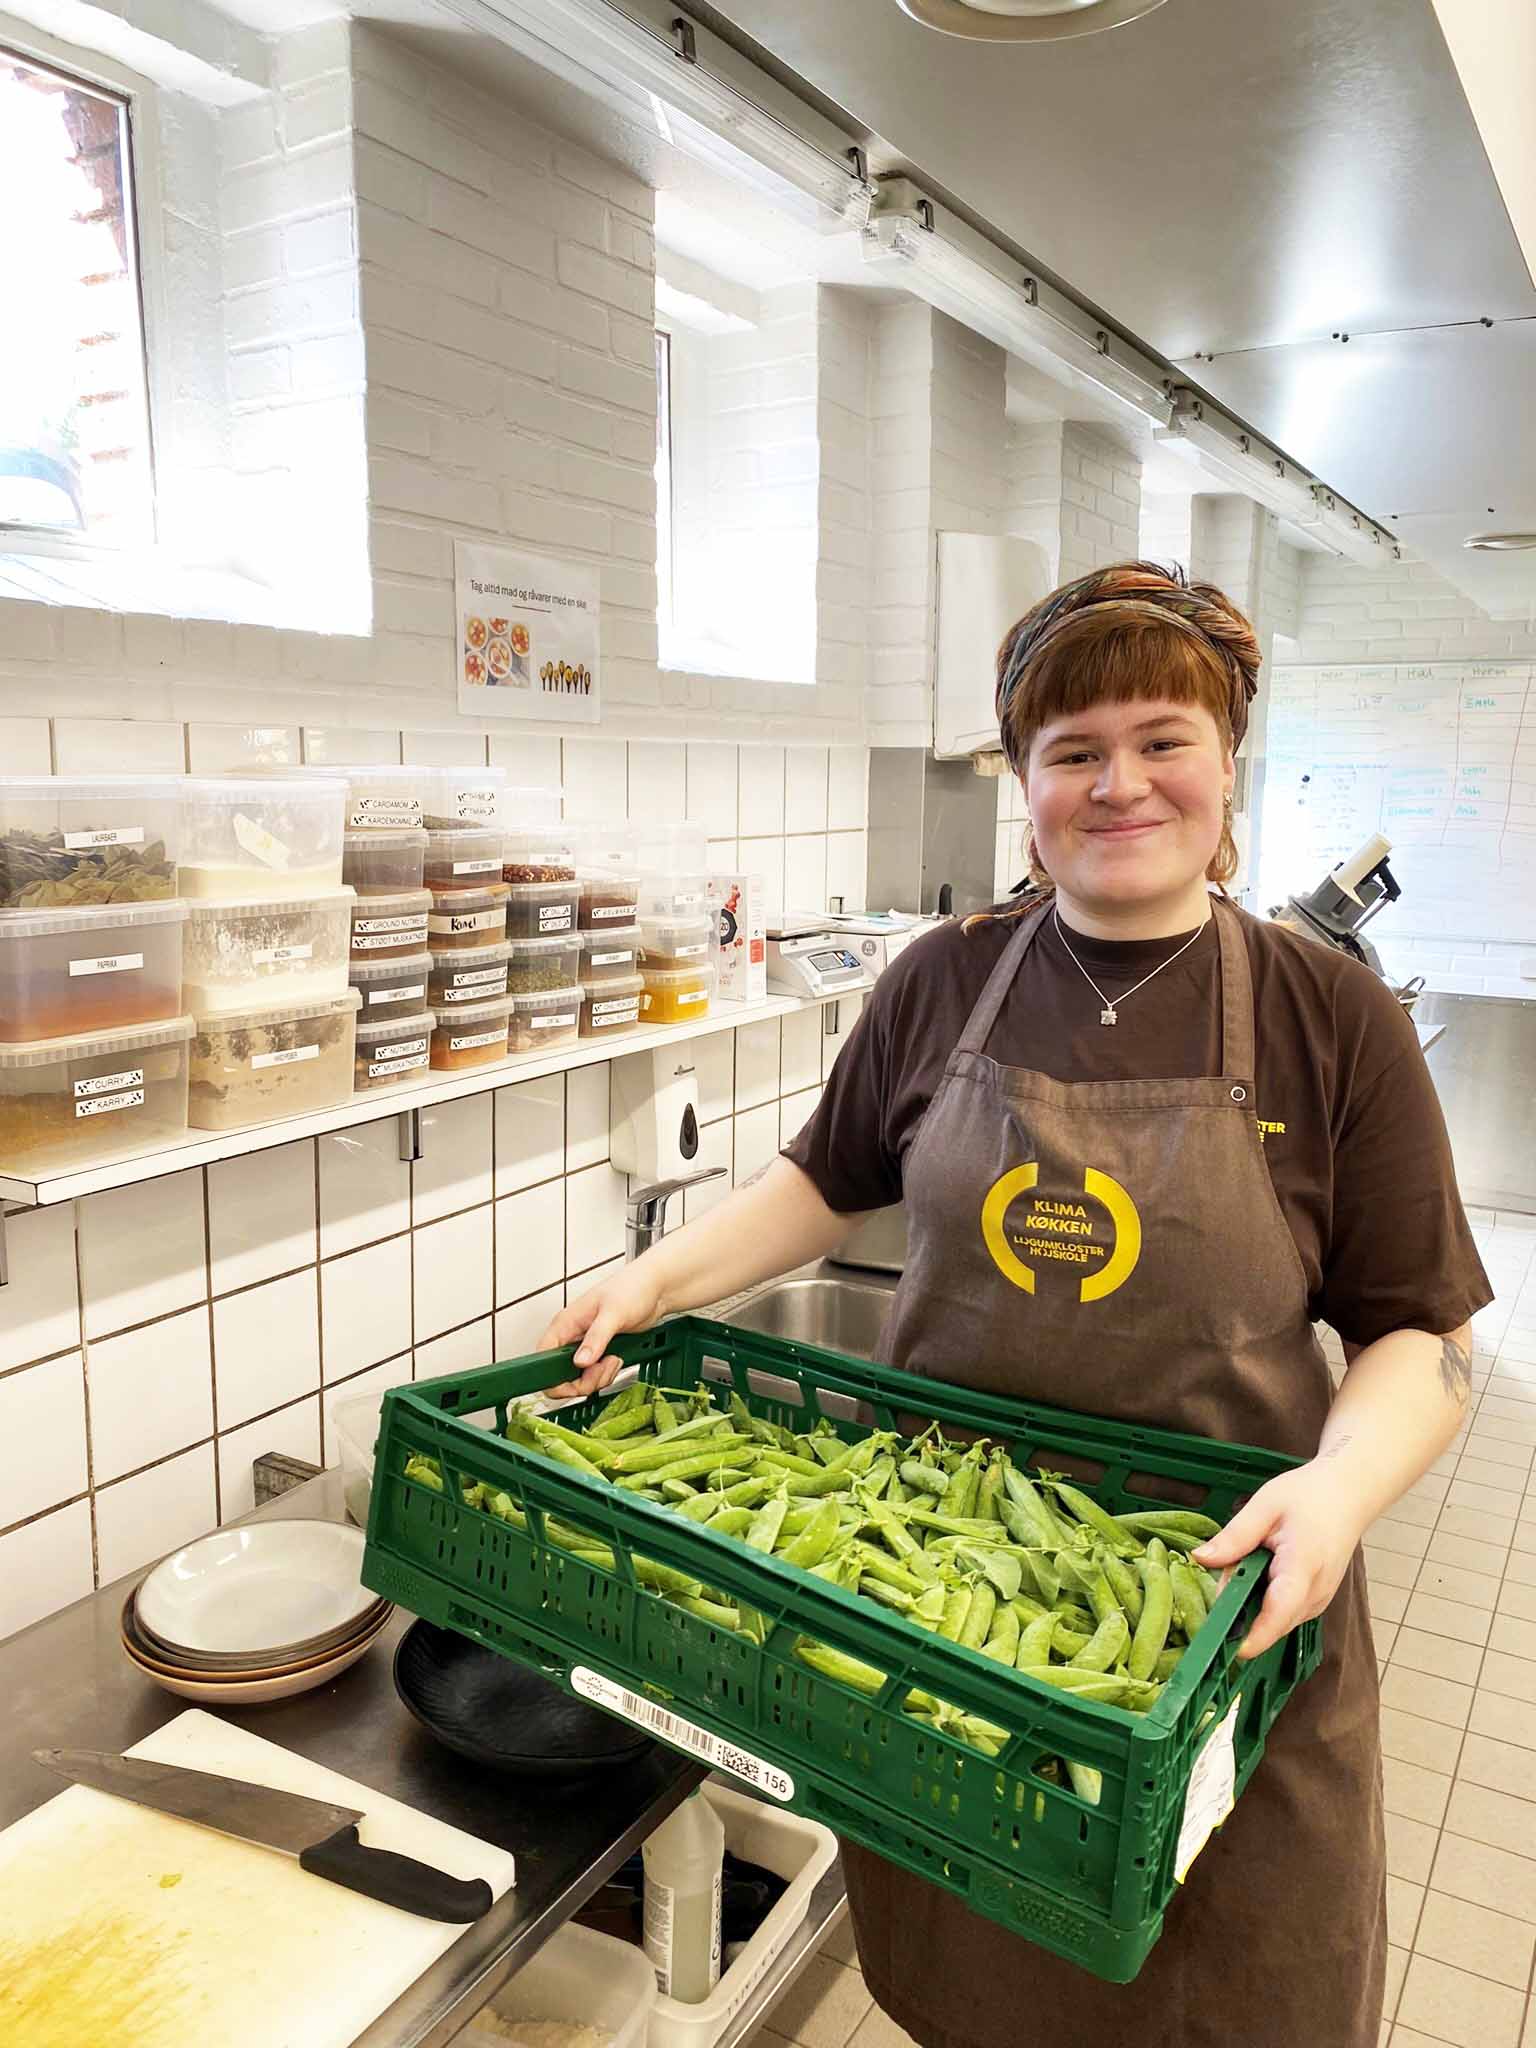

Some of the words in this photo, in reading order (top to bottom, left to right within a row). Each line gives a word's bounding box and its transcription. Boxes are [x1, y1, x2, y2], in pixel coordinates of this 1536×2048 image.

[470, 579, 482, 594] Tag
[484, 582, 500, 595] altid
[501, 586, 518, 597] mad
[518, 590, 528, 601] og
[528, 589, 551, 602] råvarer
[552, 594, 567, 606] med
[567, 598, 575, 607] en
[576, 598, 587, 609] ske
[372, 800, 409, 809] CARDAMOM
[373, 918, 400, 929] GROUND
[450, 917, 477, 932] Kanel
[94, 1075, 125, 1089] CURRY
[97, 1095, 126, 1109] KARRY
[1034, 1200, 1087, 1218] KLIMA
[1025, 1215, 1092, 1236] KØKKEN
[763, 1771, 787, 1793] 156
